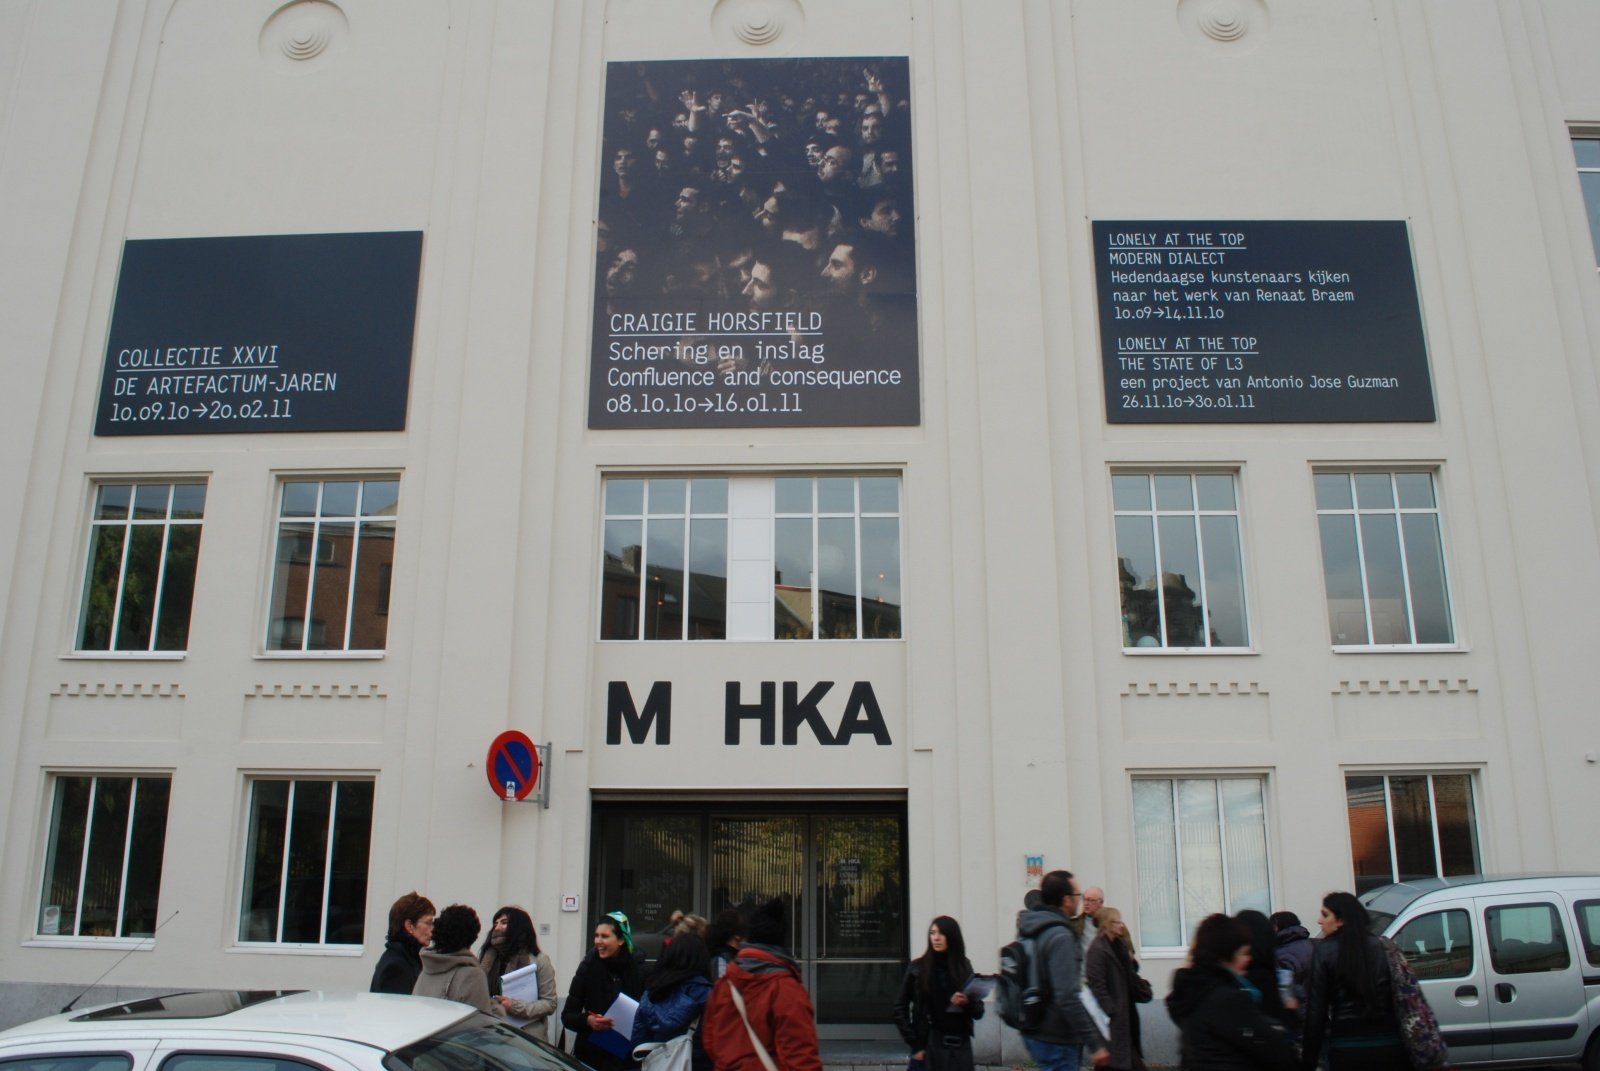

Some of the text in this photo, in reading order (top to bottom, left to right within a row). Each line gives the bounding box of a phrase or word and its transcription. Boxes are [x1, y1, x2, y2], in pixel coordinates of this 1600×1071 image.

[1108, 233, 1246, 246] LONELY AT THE TOP
[1109, 252, 1226, 265] MODERN DIALECT
[1111, 270, 1350, 286] Hedendaagse kunstenaars kijken
[1112, 289, 1355, 302] naar het werk van Renaat Braem
[610, 312, 823, 333] CRAIGIE HORSFIELD
[1118, 337, 1258, 350] LONELY AT THE TOP
[118, 345, 279, 369] COLLECTIE XXVI
[608, 340, 825, 365] Schering en inslag
[1118, 357, 1244, 371] THE STATE OF L3
[113, 373, 338, 396] DE ARTEFACTUM-JAREN
[607, 367, 902, 389] Confluence and consequence
[1120, 375, 1399, 391] een project van Antonio Jose Guzman
[606, 680, 893, 746] M HKA
